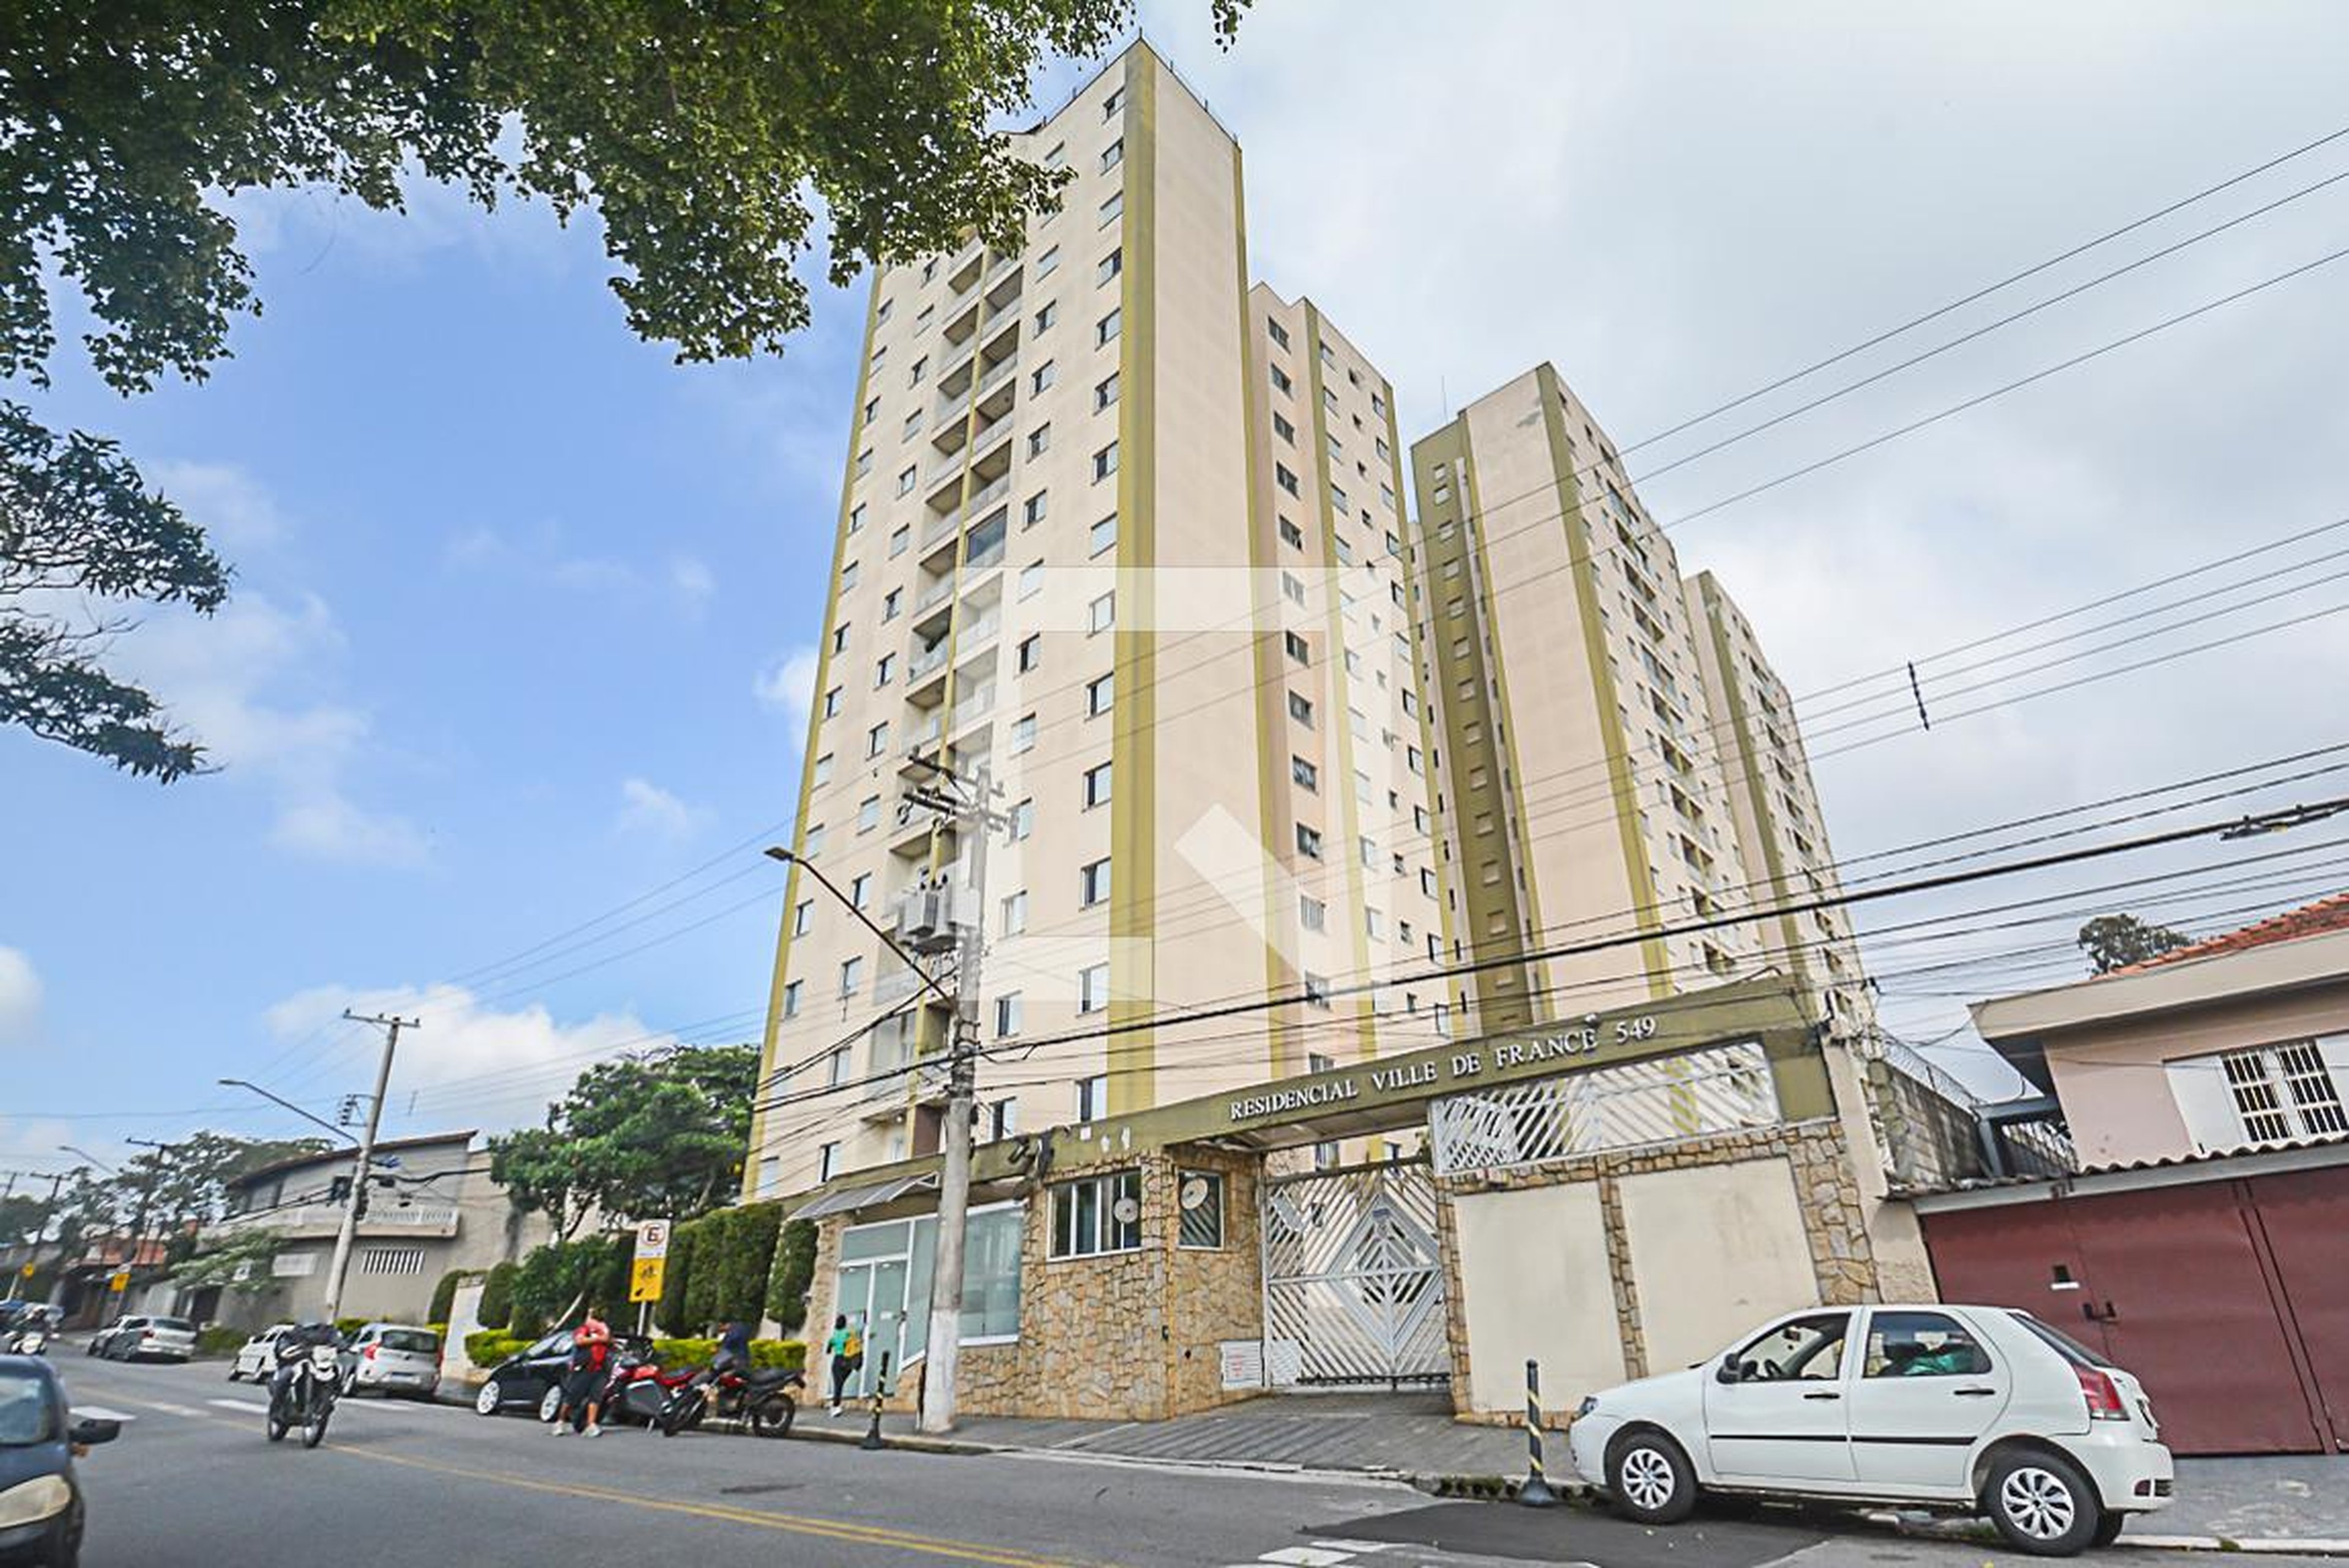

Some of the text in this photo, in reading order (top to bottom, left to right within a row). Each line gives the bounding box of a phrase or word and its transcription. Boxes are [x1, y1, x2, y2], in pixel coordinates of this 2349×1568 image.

[1230, 1015, 1657, 1120] RESIDENCIAL VILLE DE FRANCE 549
